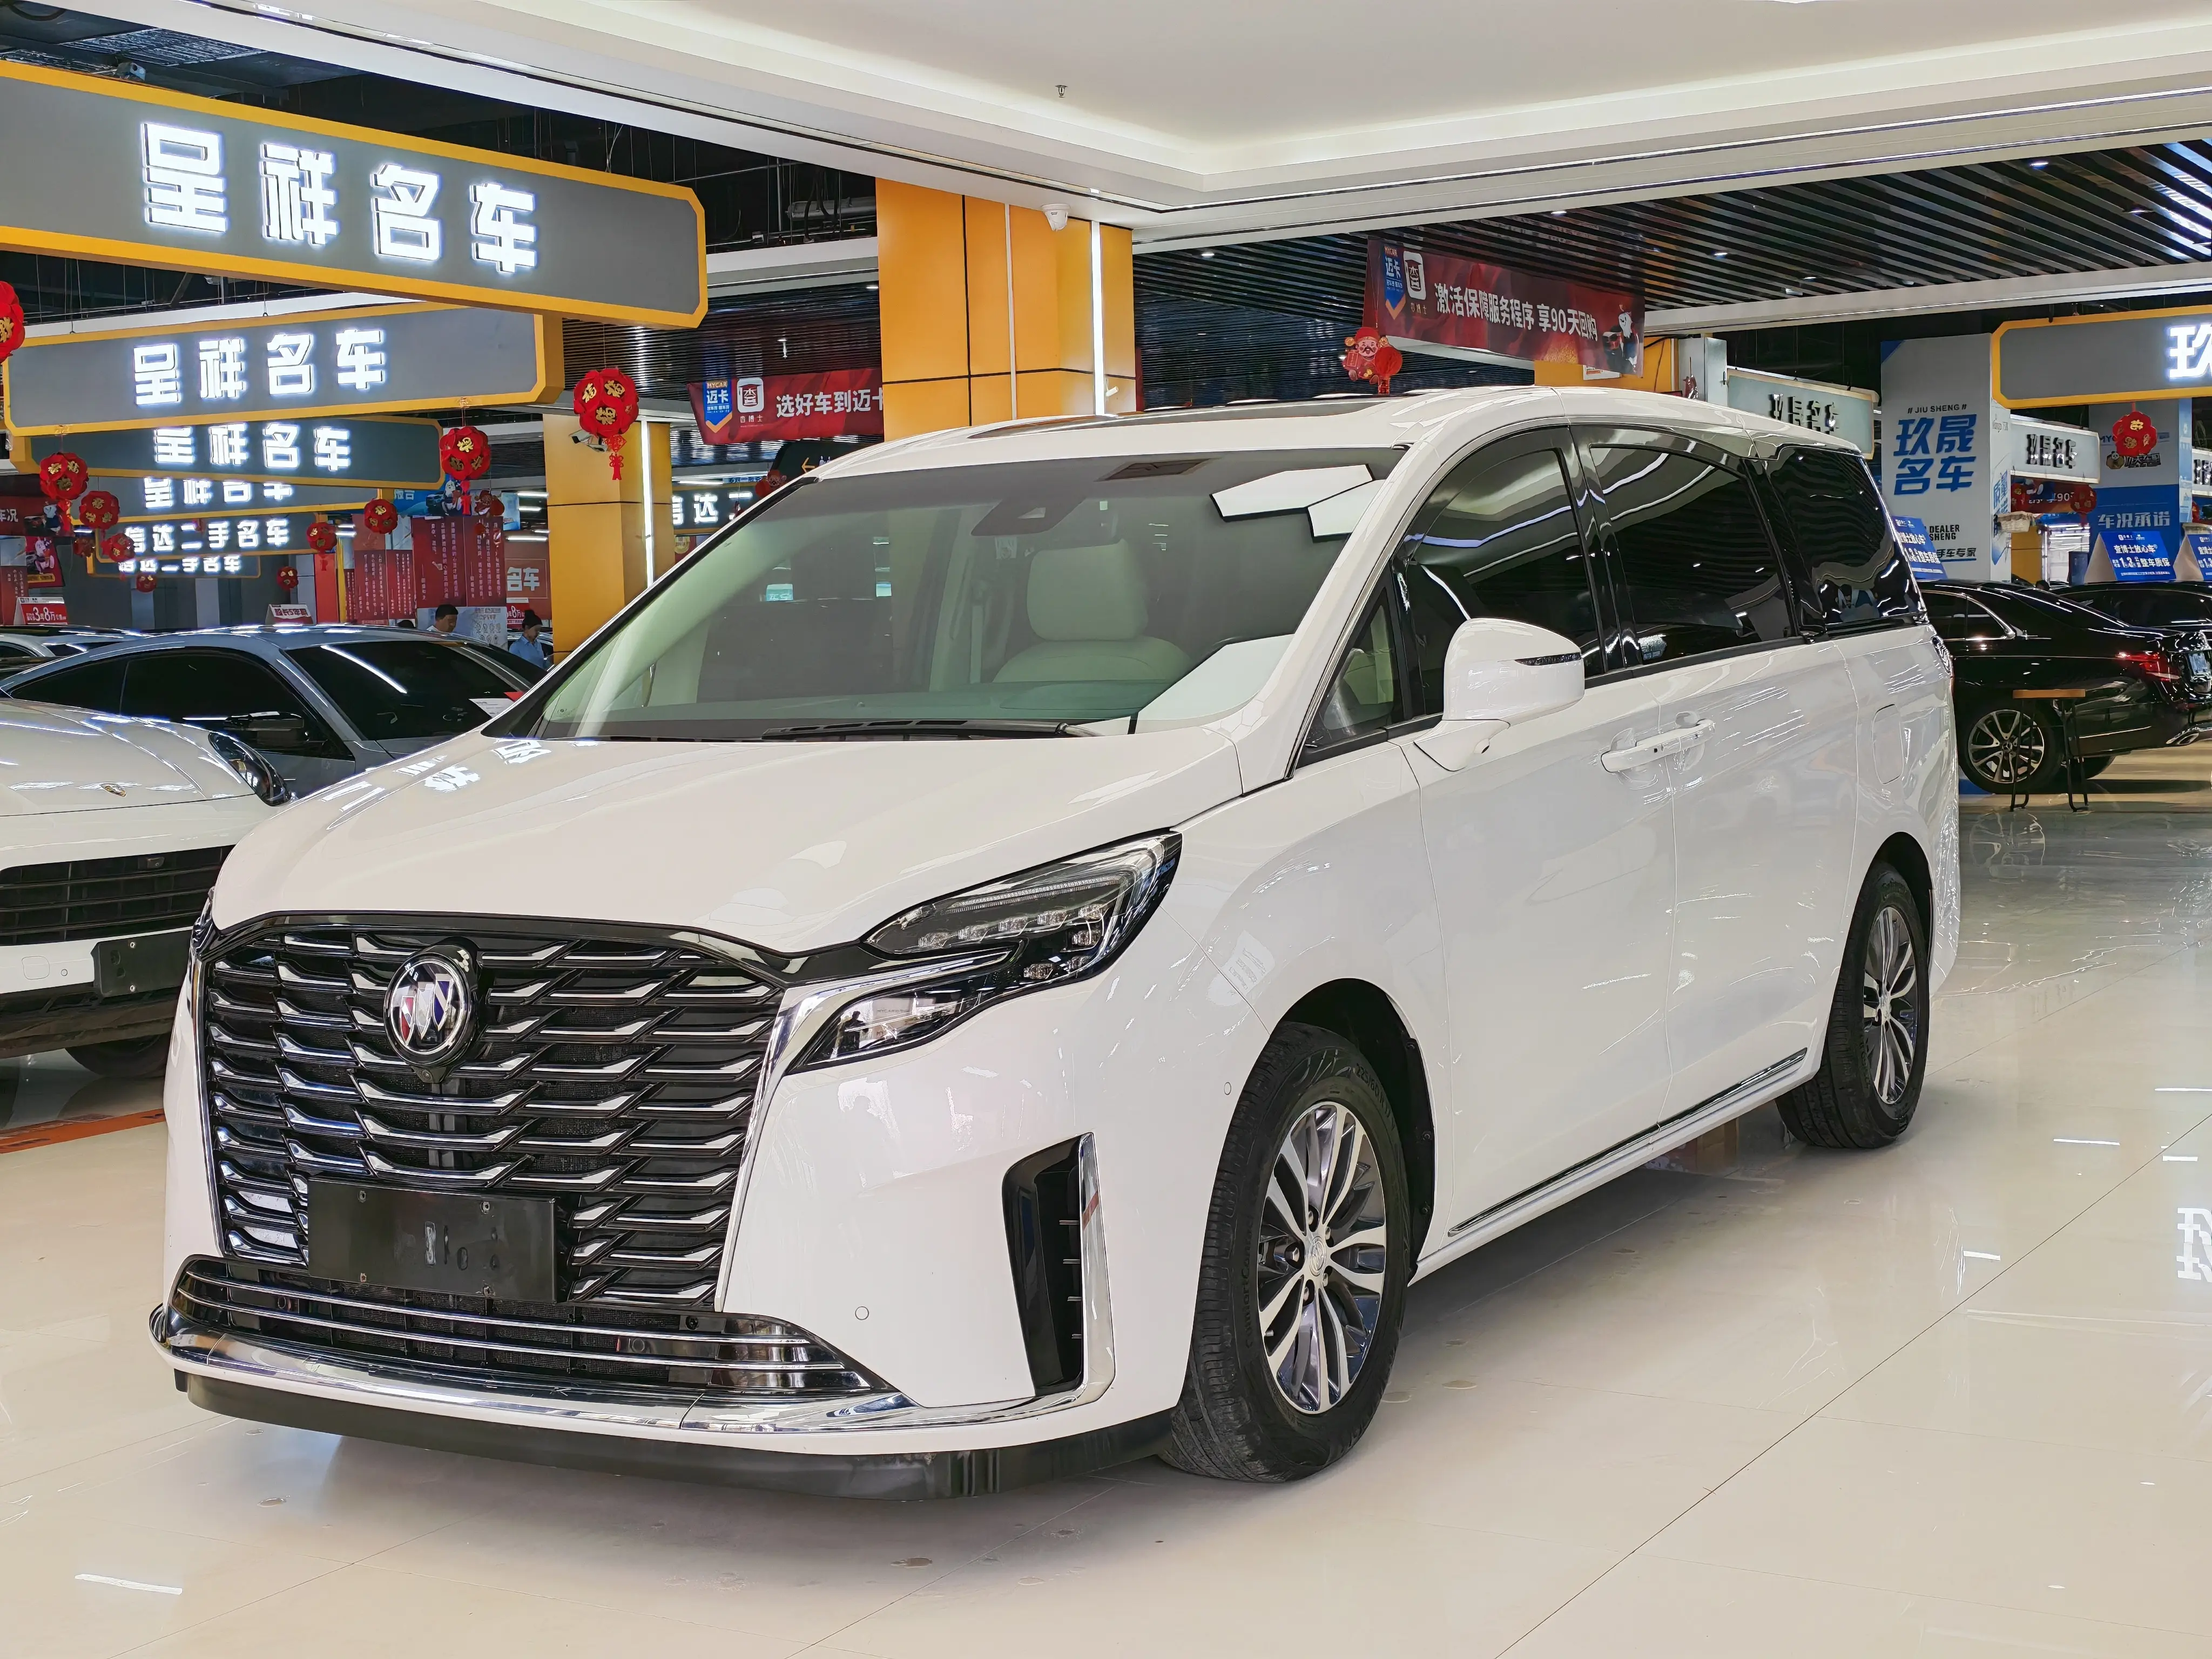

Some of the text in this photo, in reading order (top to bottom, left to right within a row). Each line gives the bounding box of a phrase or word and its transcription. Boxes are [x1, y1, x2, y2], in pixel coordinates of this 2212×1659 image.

[141, 123, 537, 273] 呈祥名车
[1434, 283, 1598, 341] 激活保障服务程序 享90天回购
[133, 329, 385, 406] 呈祥名车
[706, 389, 729, 404] 迈卡
[1930, 404, 1960, 413] SHENG
[154, 422, 350, 471] 呈祥名车
[1893, 414, 1977, 456] 玖晟
[1894, 456, 1977, 495] 名车
[125, 518, 288, 554] 信达二手名车
[1929, 524, 1960, 534] DEALER
[1929, 532, 1956, 541] SHENG
[2098, 511, 2170, 529] 车况承诺
[507, 567, 540, 591] 名车
